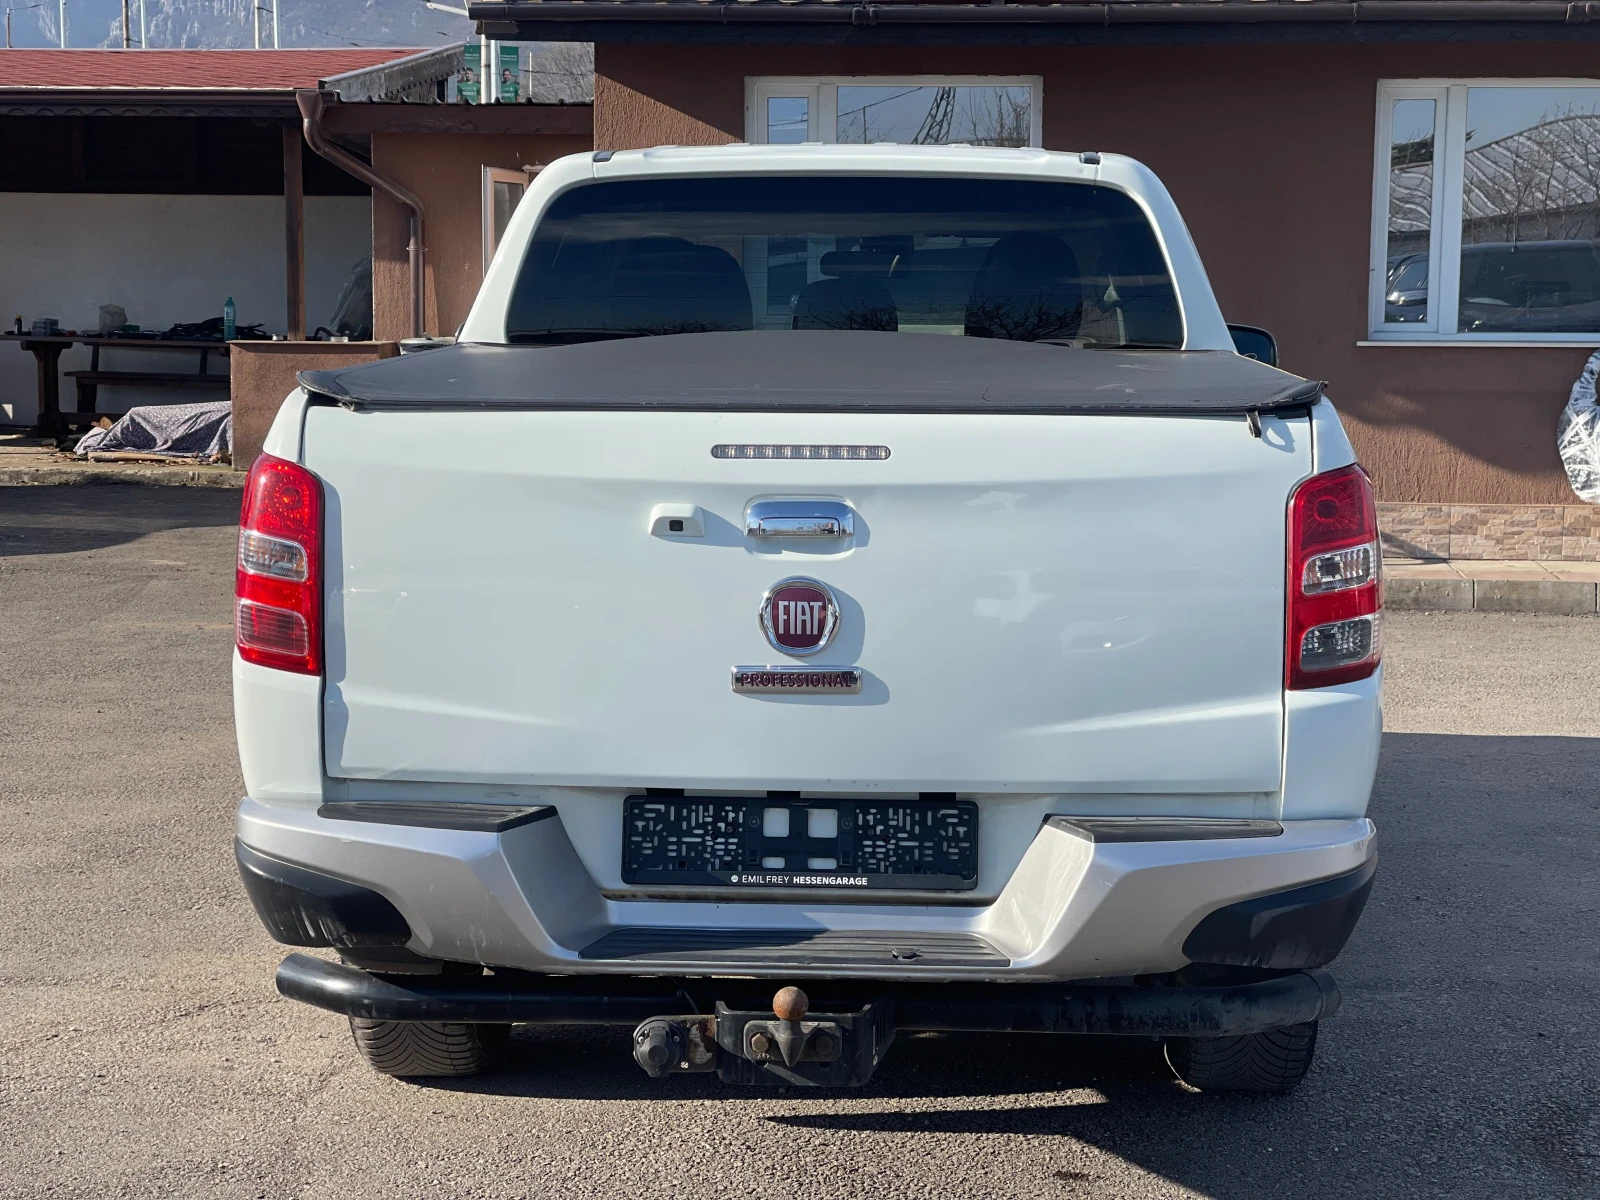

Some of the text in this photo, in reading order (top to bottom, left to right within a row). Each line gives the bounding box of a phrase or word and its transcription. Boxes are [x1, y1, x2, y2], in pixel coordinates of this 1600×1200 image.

[778, 600, 823, 635] FIAT
[740, 673, 852, 688] PROFESSIONAL
[742, 875, 868, 886] EMIL FREY HESSENGARAGE
